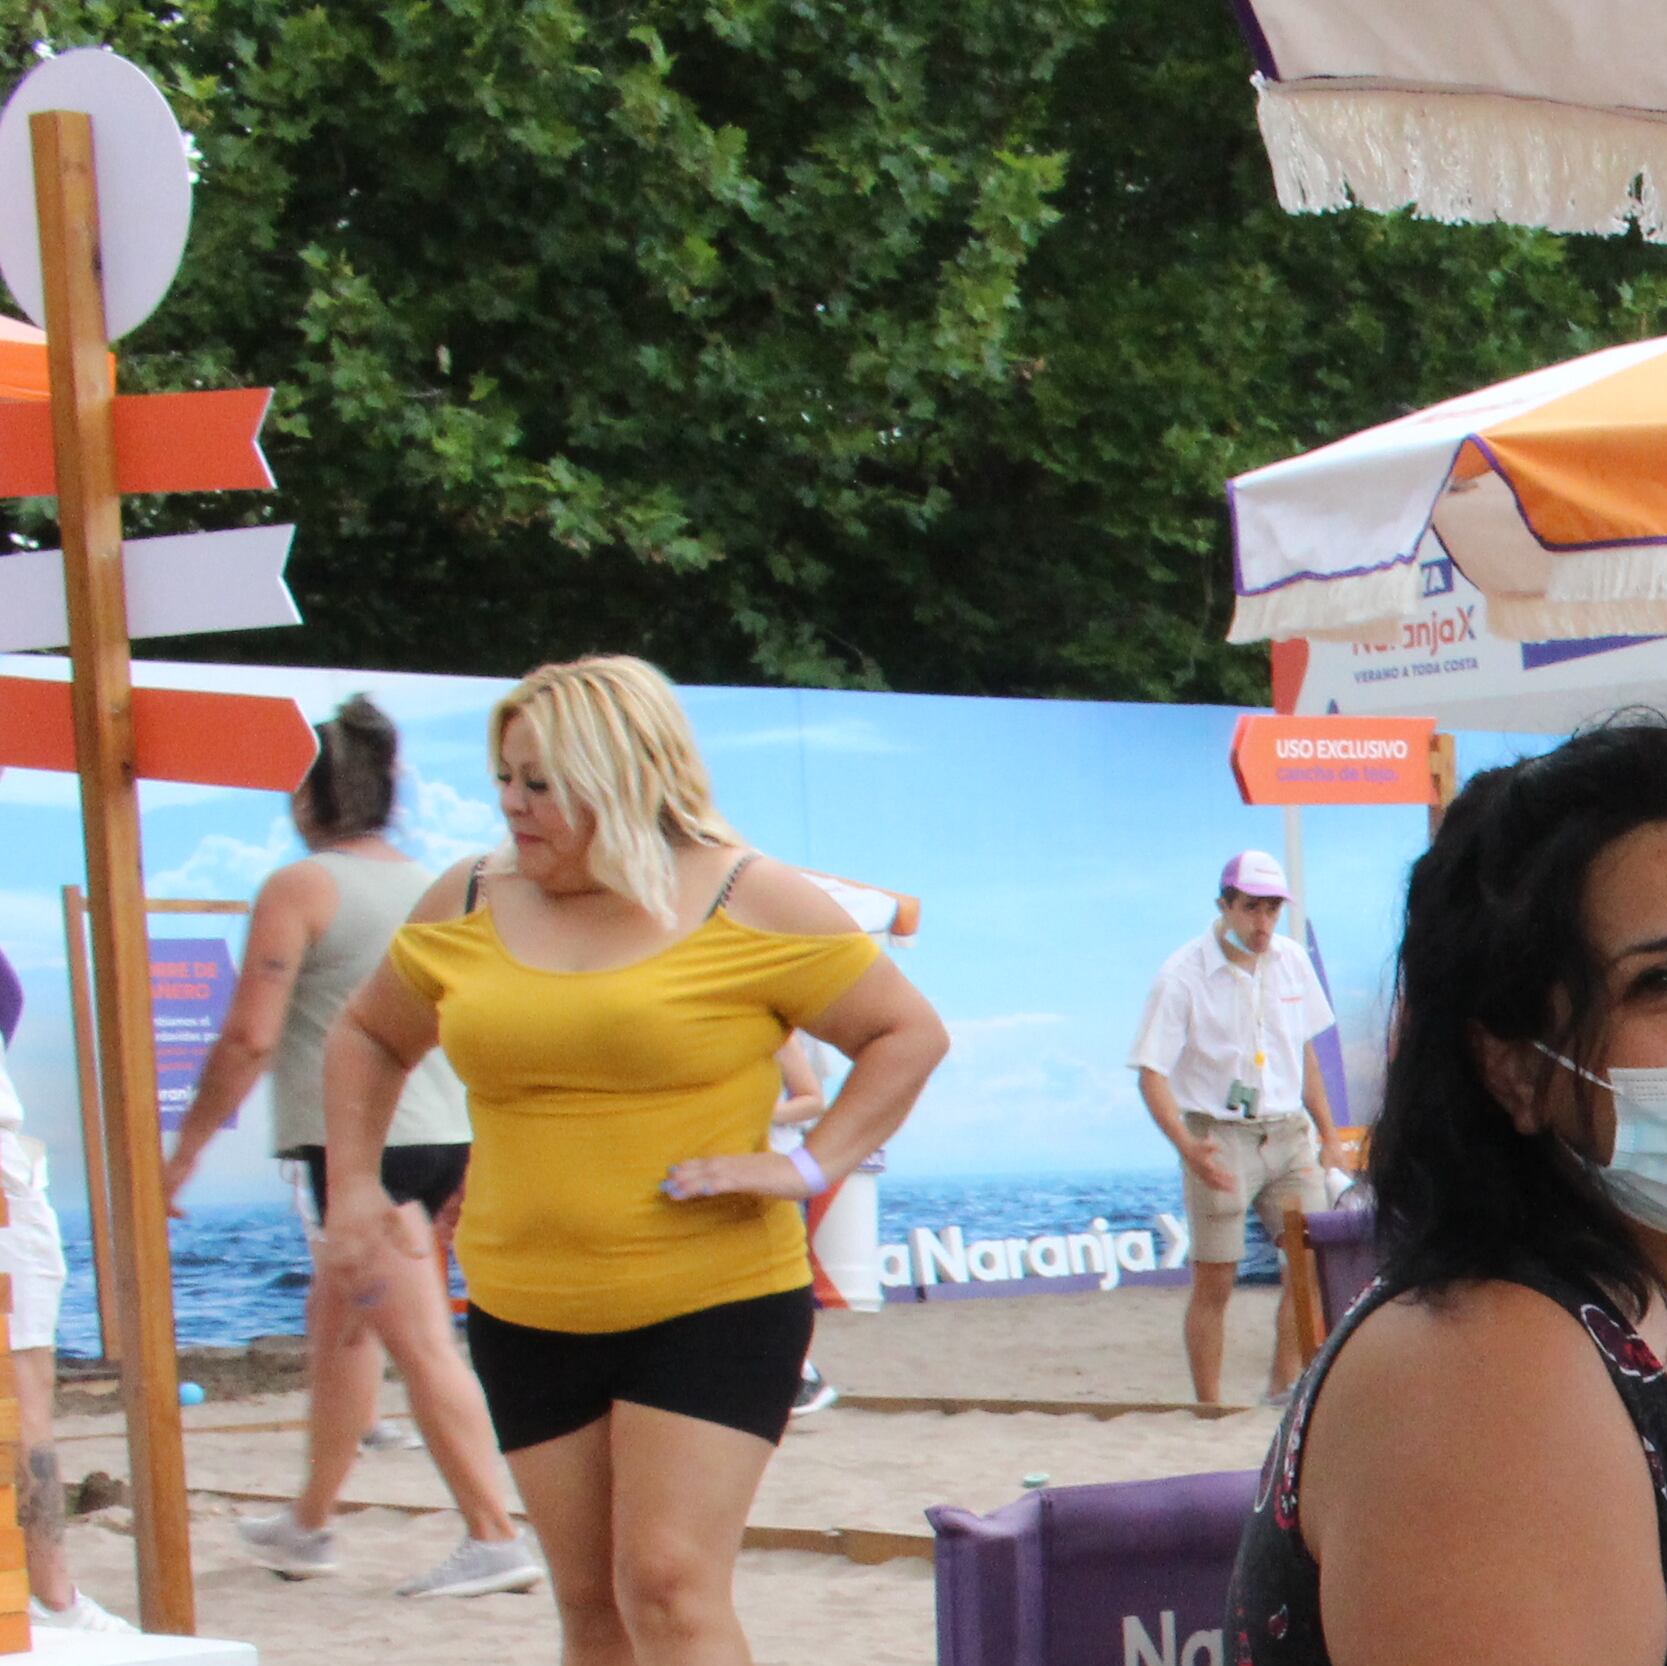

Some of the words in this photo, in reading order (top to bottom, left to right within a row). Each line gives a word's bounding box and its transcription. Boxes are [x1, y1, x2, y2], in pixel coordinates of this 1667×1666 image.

[1354, 668, 1399, 684] VERANO
[1443, 657, 1479, 672] COSTA
[1276, 739, 1312, 759] USO
[1317, 740, 1408, 759] EXCLUSIVO
